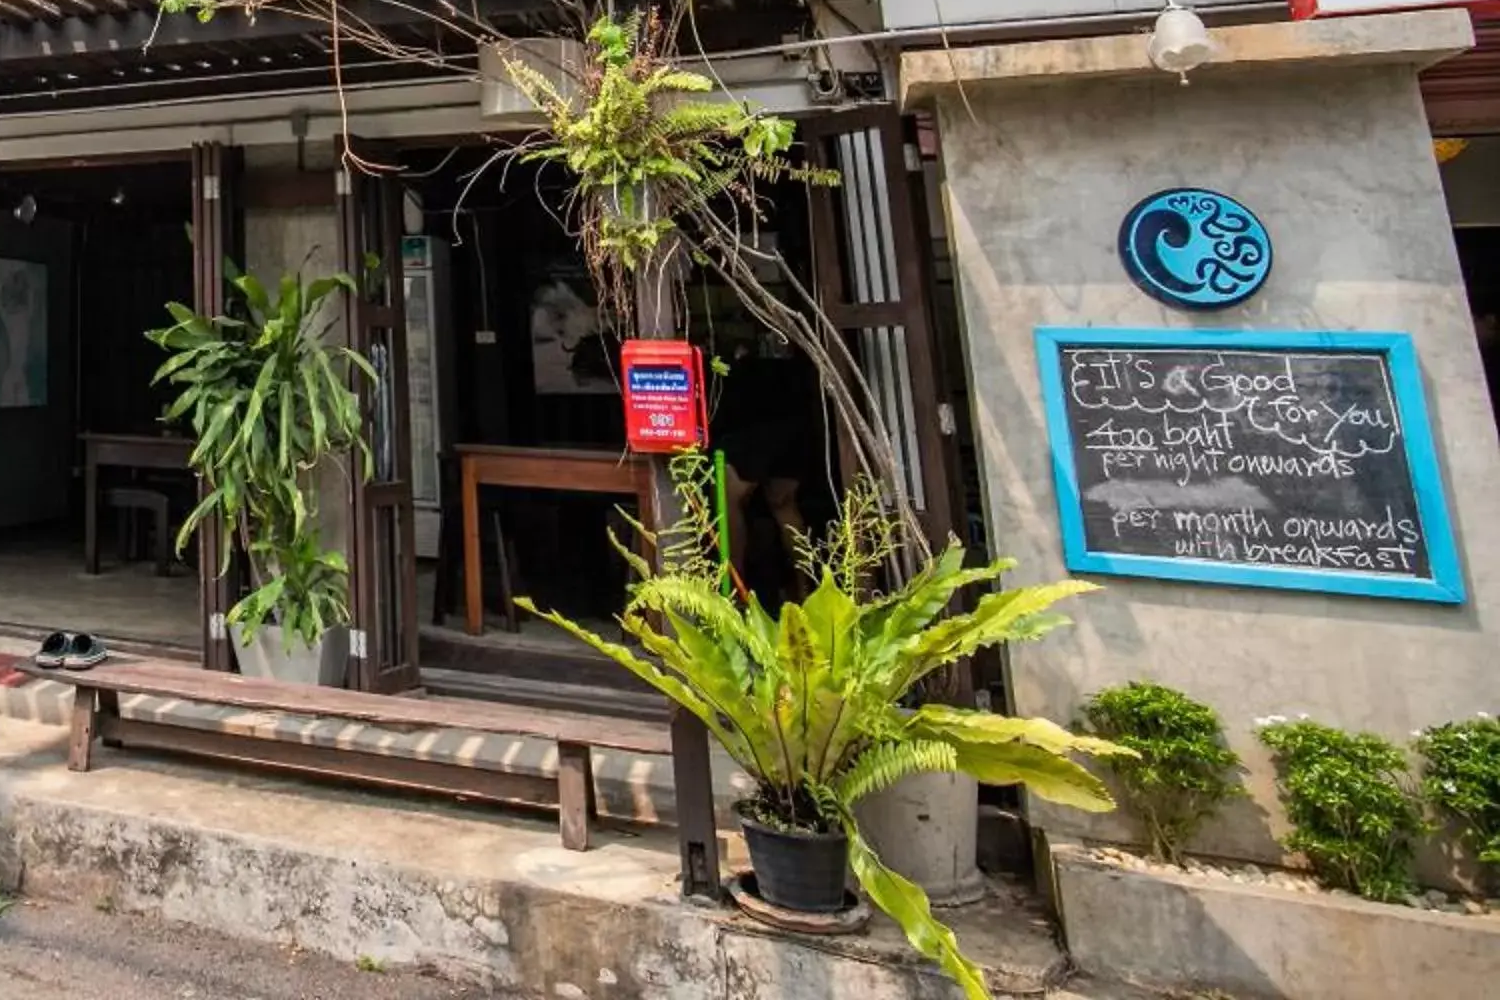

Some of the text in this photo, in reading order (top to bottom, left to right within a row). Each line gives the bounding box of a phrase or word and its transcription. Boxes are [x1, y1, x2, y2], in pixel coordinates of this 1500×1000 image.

[1089, 353, 1155, 389] It's
[1086, 412, 1234, 449] 400 baht
[1102, 447, 1355, 487] per night onwards
[1112, 505, 1420, 543] per month onwards
[1175, 534, 1237, 560] with
